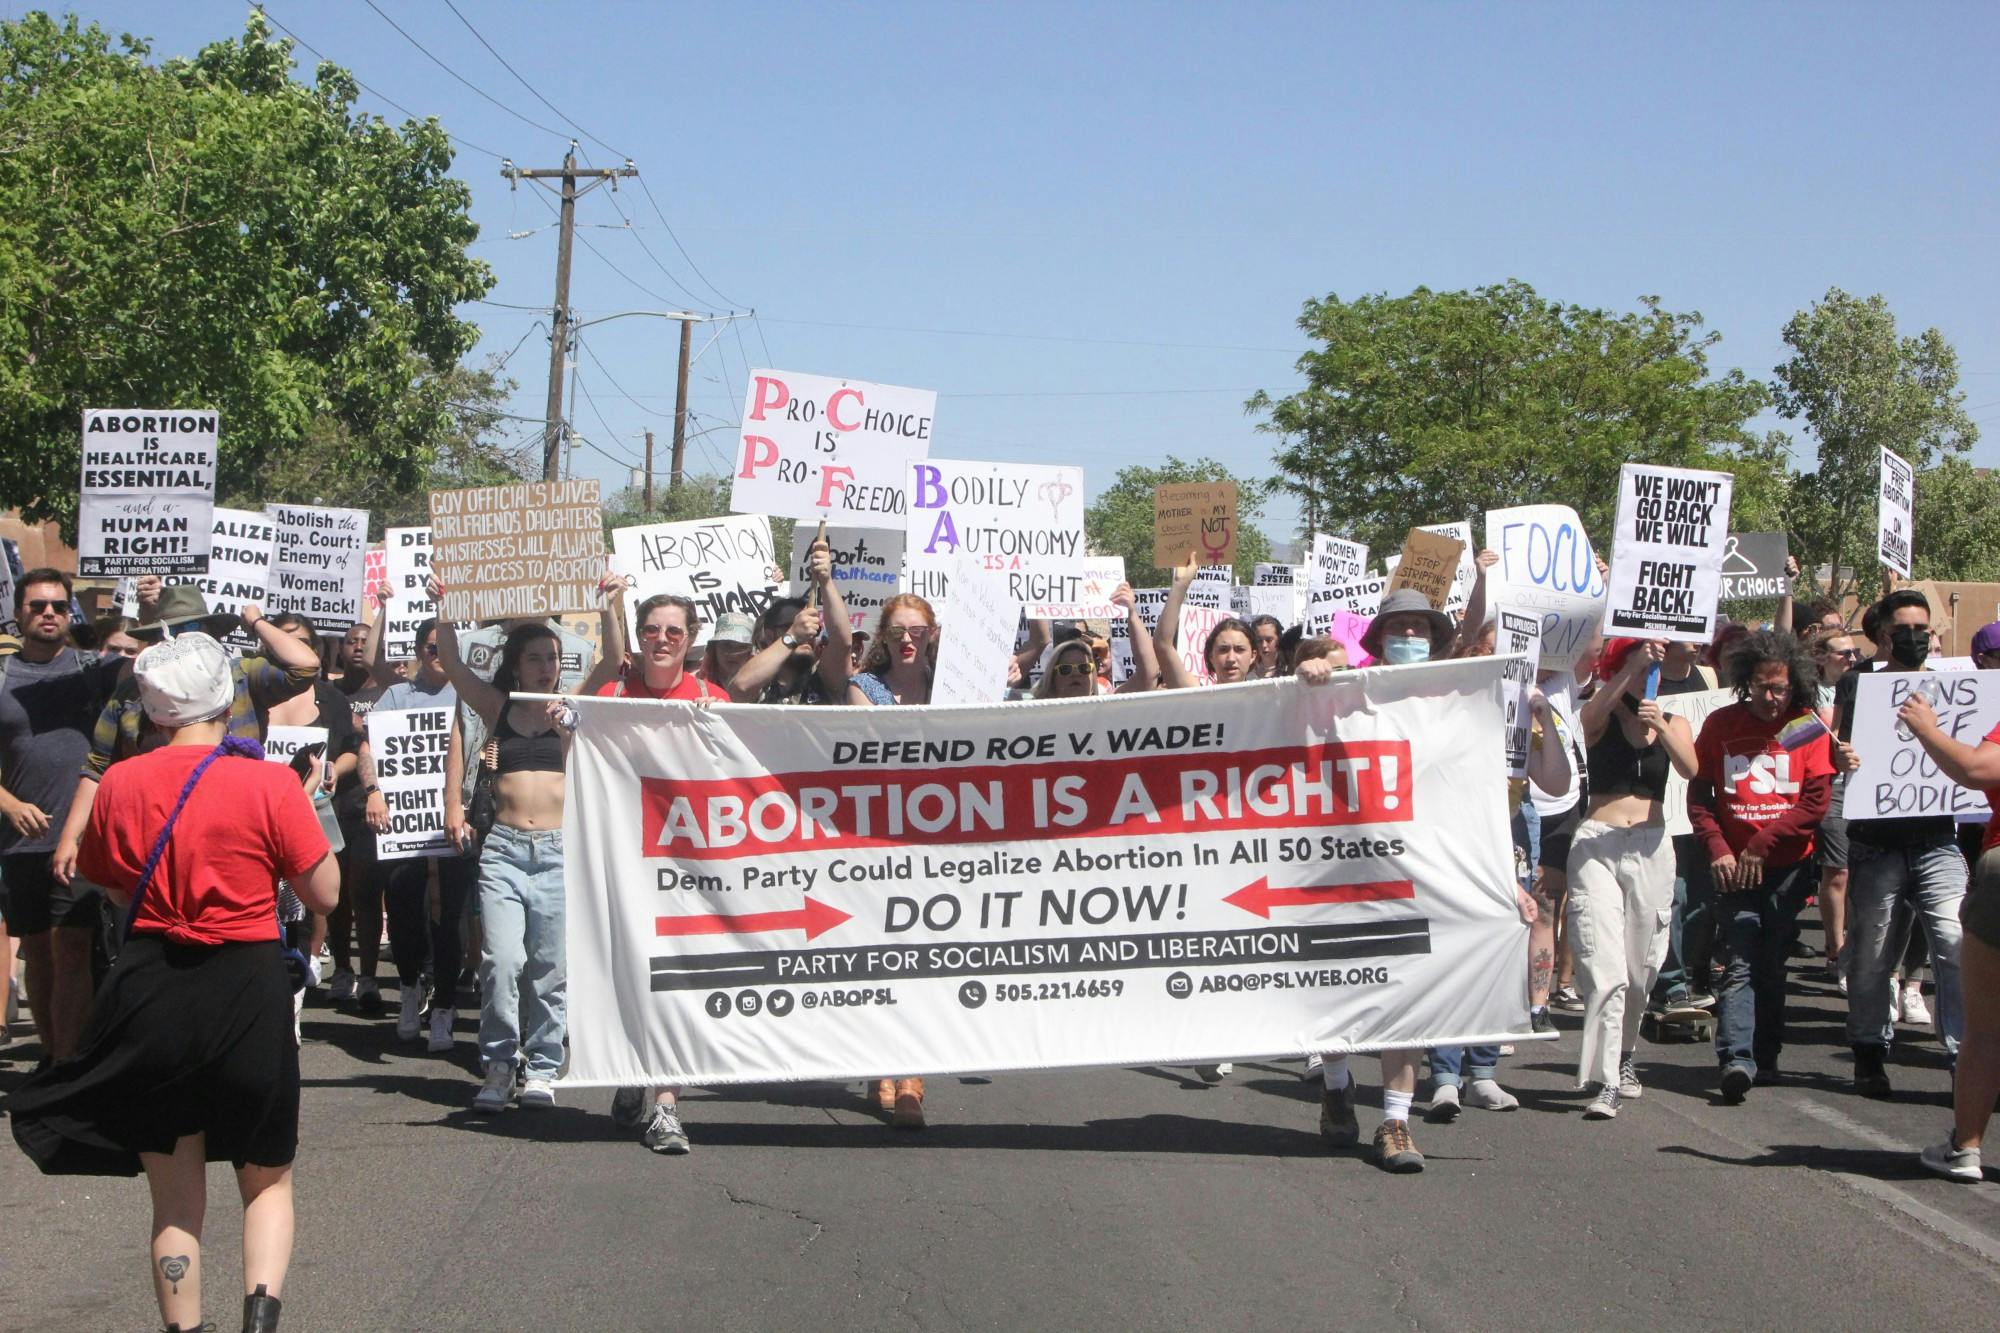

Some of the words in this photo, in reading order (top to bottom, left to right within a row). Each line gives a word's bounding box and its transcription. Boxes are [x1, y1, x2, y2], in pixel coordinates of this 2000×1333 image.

[88, 416, 215, 433] ABORTION
[143, 437, 159, 450] IS
[815, 431, 836, 453] IS
[86, 452, 213, 467] HEALTHCARE,
[84, 470, 212, 490] ESSENTIAL,
[1634, 475, 1663, 499] WE
[1667, 478, 1721, 504] WON'T
[431, 491, 463, 515] GOV
[1883, 482, 1910, 514] ABORTION
[278, 509, 333, 529] Abolish
[337, 515, 357, 531] the
[1213, 505, 1226, 514] MY
[1636, 498, 1662, 521] GO
[1664, 501, 1713, 526] BACK
[101, 518, 188, 532] HUMAN
[212, 521, 273, 542] ALIZE
[1201, 517, 1230, 533] NOT
[1635, 519, 1662, 543] WE
[1667, 523, 1708, 548] WILL
[1893, 517, 1902, 536] ON
[104, 537, 188, 554] RIGHT!
[436, 546, 443, 561] &
[445, 537, 515, 563] MISTRESSES
[519, 535, 549, 557] WILL
[550, 530, 605, 559] ALWAYS
[641, 516, 775, 572] ABORTION
[1326, 540, 1357, 560] WOMEN
[105, 557, 133, 566] PARTY
[134, 557, 150, 565] FOR
[151, 556, 194, 565] SOCIALISM
[211, 546, 269, 566] RTION
[279, 547, 331, 569] Enemy
[335, 552, 349, 569] of
[983, 555, 1004, 570] IS
[1008, 555, 1022, 569] A
[1319, 555, 1346, 574] WON'T
[1348, 562, 1360, 577] GO
[1414, 556, 1441, 570] STOP
[104, 567, 121, 575] AND
[124, 566, 171, 575] LIBERATION
[441, 564, 473, 585] HAVE
[476, 561, 524, 583] ACCESS
[526, 560, 543, 578] TO
[1271, 566, 1289, 574] THE
[1400, 566, 1447, 587] STRIPPING
[1638, 560, 1696, 589] FIGHT
[220, 582, 265, 600] AND
[280, 573, 344, 593] Women!
[405, 574, 430, 588] BY
[689, 571, 722, 593] IS
[1009, 572, 1082, 603] RIGHT
[1737, 576, 1786, 597] CHOICE
[266, 592, 306, 613] Fight
[311, 596, 356, 615] Back!
[439, 589, 471, 620] POOR
[473, 585, 548, 619] MINORITIES
[550, 584, 583, 611] WILL
[1186, 593, 1219, 601] UMAN
[1348, 599, 1359, 609] IS
[1632, 586, 1695, 614] BACK!
[1141, 606, 1150, 615] IS
[1617, 611, 1631, 619] Party
[1642, 612, 1667, 621] Socialism
[1668, 614, 1678, 622] and
[1678, 614, 1704, 623] Liberation
[1505, 615, 1513, 628] NO
[1513, 617, 1537, 634] APOLOGIES
[1890, 677, 1979, 709] BNS
[406, 712, 446, 732] THE
[1507, 701, 1518, 724] ON
[385, 733, 450, 756] SYSTE
[833, 739, 975, 764] DEFEND
[986, 733, 1056, 760] ROE
[1068, 732, 1094, 756] V.
[1107, 723, 1224, 753] WADE!
[377, 758, 398, 778] IS
[1723, 753, 1800, 795] PSL
[384, 788, 438, 811] FIGHT
[656, 782, 1005, 849] ABORTION
[1032, 775, 1088, 828] IS
[1109, 772, 1162, 825] A
[1180, 755, 1399, 822] RIGHT!
[384, 843, 400, 852] PSL
[402, 843, 416, 851] Party
[657, 868, 731, 892] Dem.
[743, 866, 817, 891] Party
[828, 855, 912, 883] Could
[924, 851, 1042, 884] Legalize
[1052, 845, 1183, 872] Abortion
[1193, 843, 1219, 865] In
[1230, 838, 1268, 865] All
[1278, 836, 1312, 862] 50
[1321, 836, 1405, 861] States
[885, 893, 962, 933] DO
[980, 891, 1023, 929] IT
[1039, 884, 1188, 927] NOW!
[777, 953, 857, 976] PARTY
[867, 951, 919, 973] FOR
[928, 943, 1070, 969] SOCIALISM
[1079, 940, 1139, 963] AND
[1148, 933, 1300, 960] LIBERATION
[995, 978, 1124, 1002] 505.221.6659
